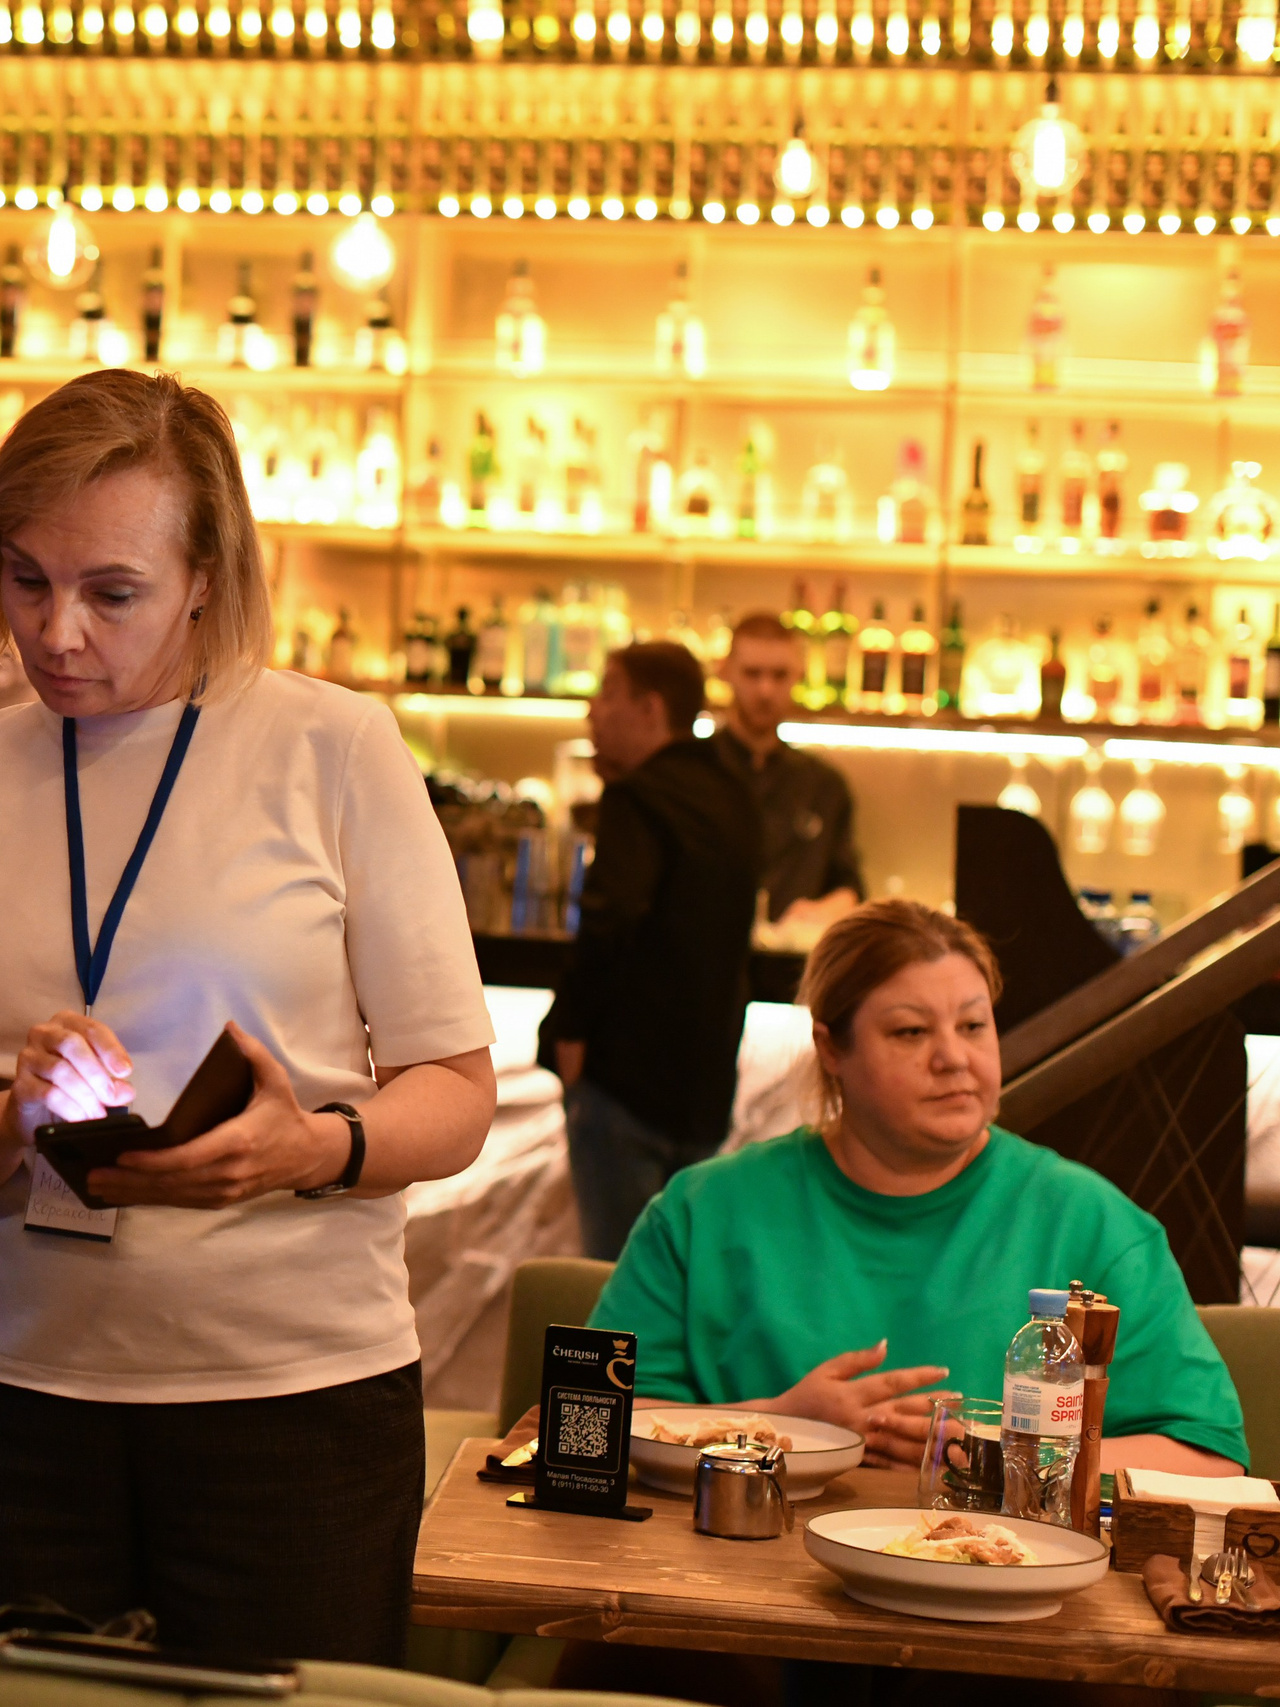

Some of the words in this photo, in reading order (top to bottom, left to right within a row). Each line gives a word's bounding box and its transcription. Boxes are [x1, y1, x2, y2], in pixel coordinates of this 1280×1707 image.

[557, 1392, 581, 1401] СИСТЕМА
[582, 1394, 617, 1405] ЛОЯЛЬНОСТИ
[546, 1470, 570, 1480] Малая
[557, 1481, 575, 1490] (911)
